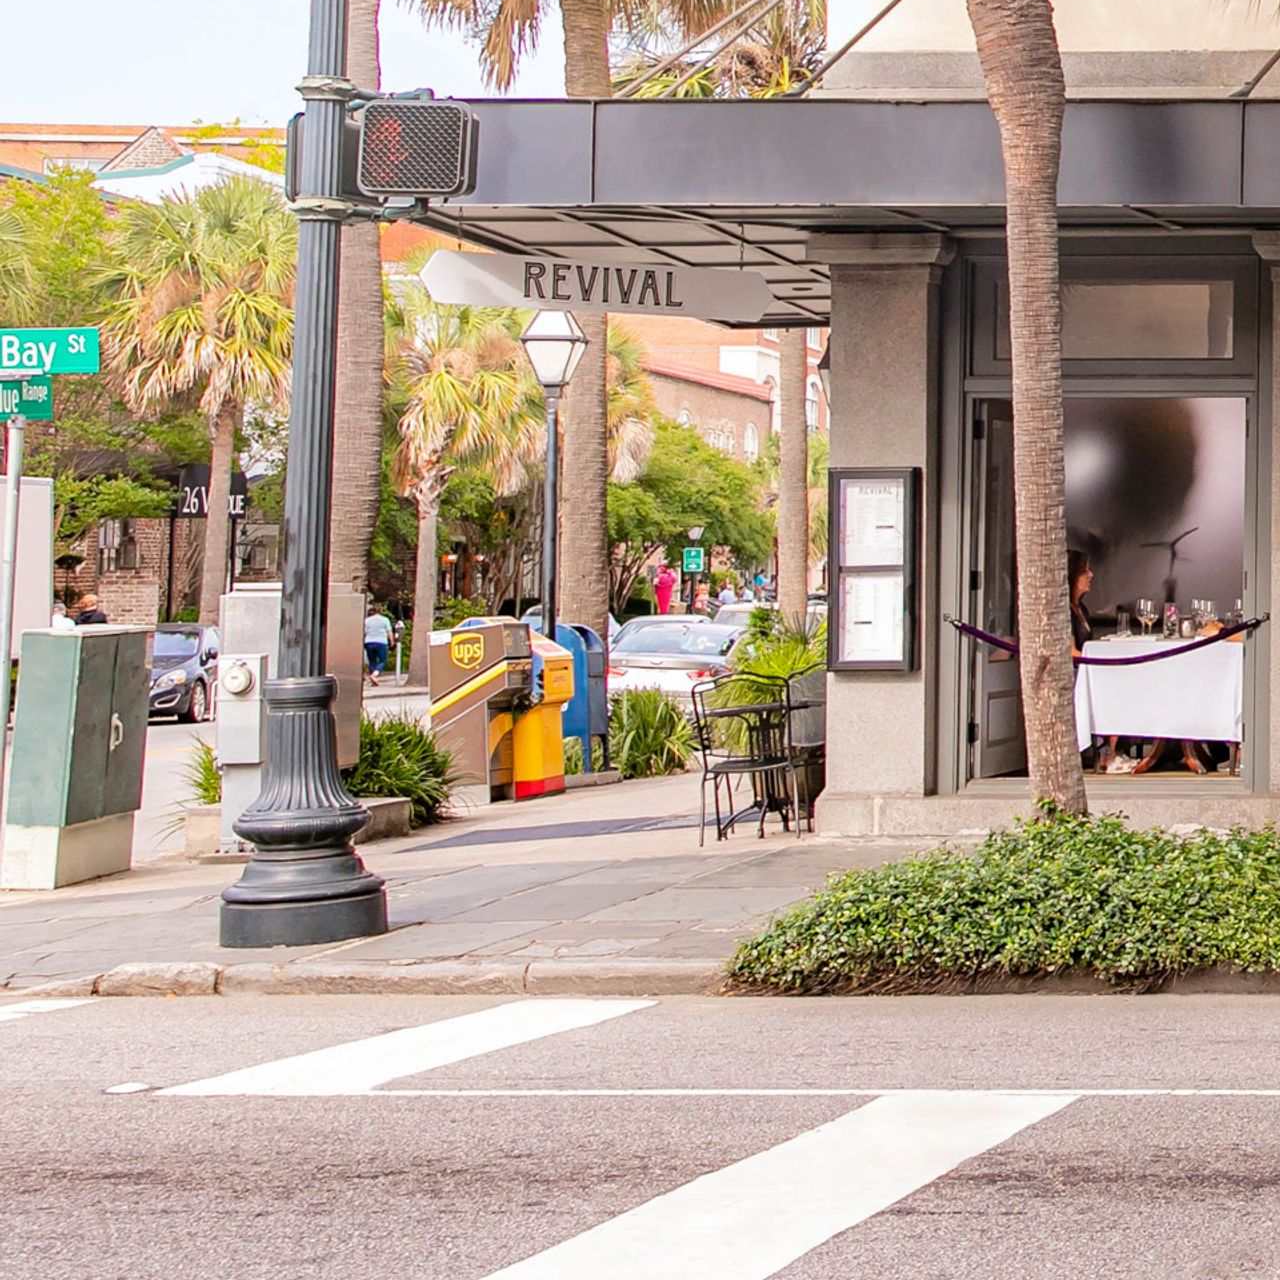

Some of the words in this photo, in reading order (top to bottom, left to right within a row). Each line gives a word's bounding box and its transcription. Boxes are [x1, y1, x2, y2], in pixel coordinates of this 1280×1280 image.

[523, 261, 683, 307] REVIVAL
[1, 335, 57, 372] Bay
[67, 333, 86, 354] St
[22, 381, 48, 403] Range
[182, 486, 199, 514] 26
[453, 644, 481, 663] ups
